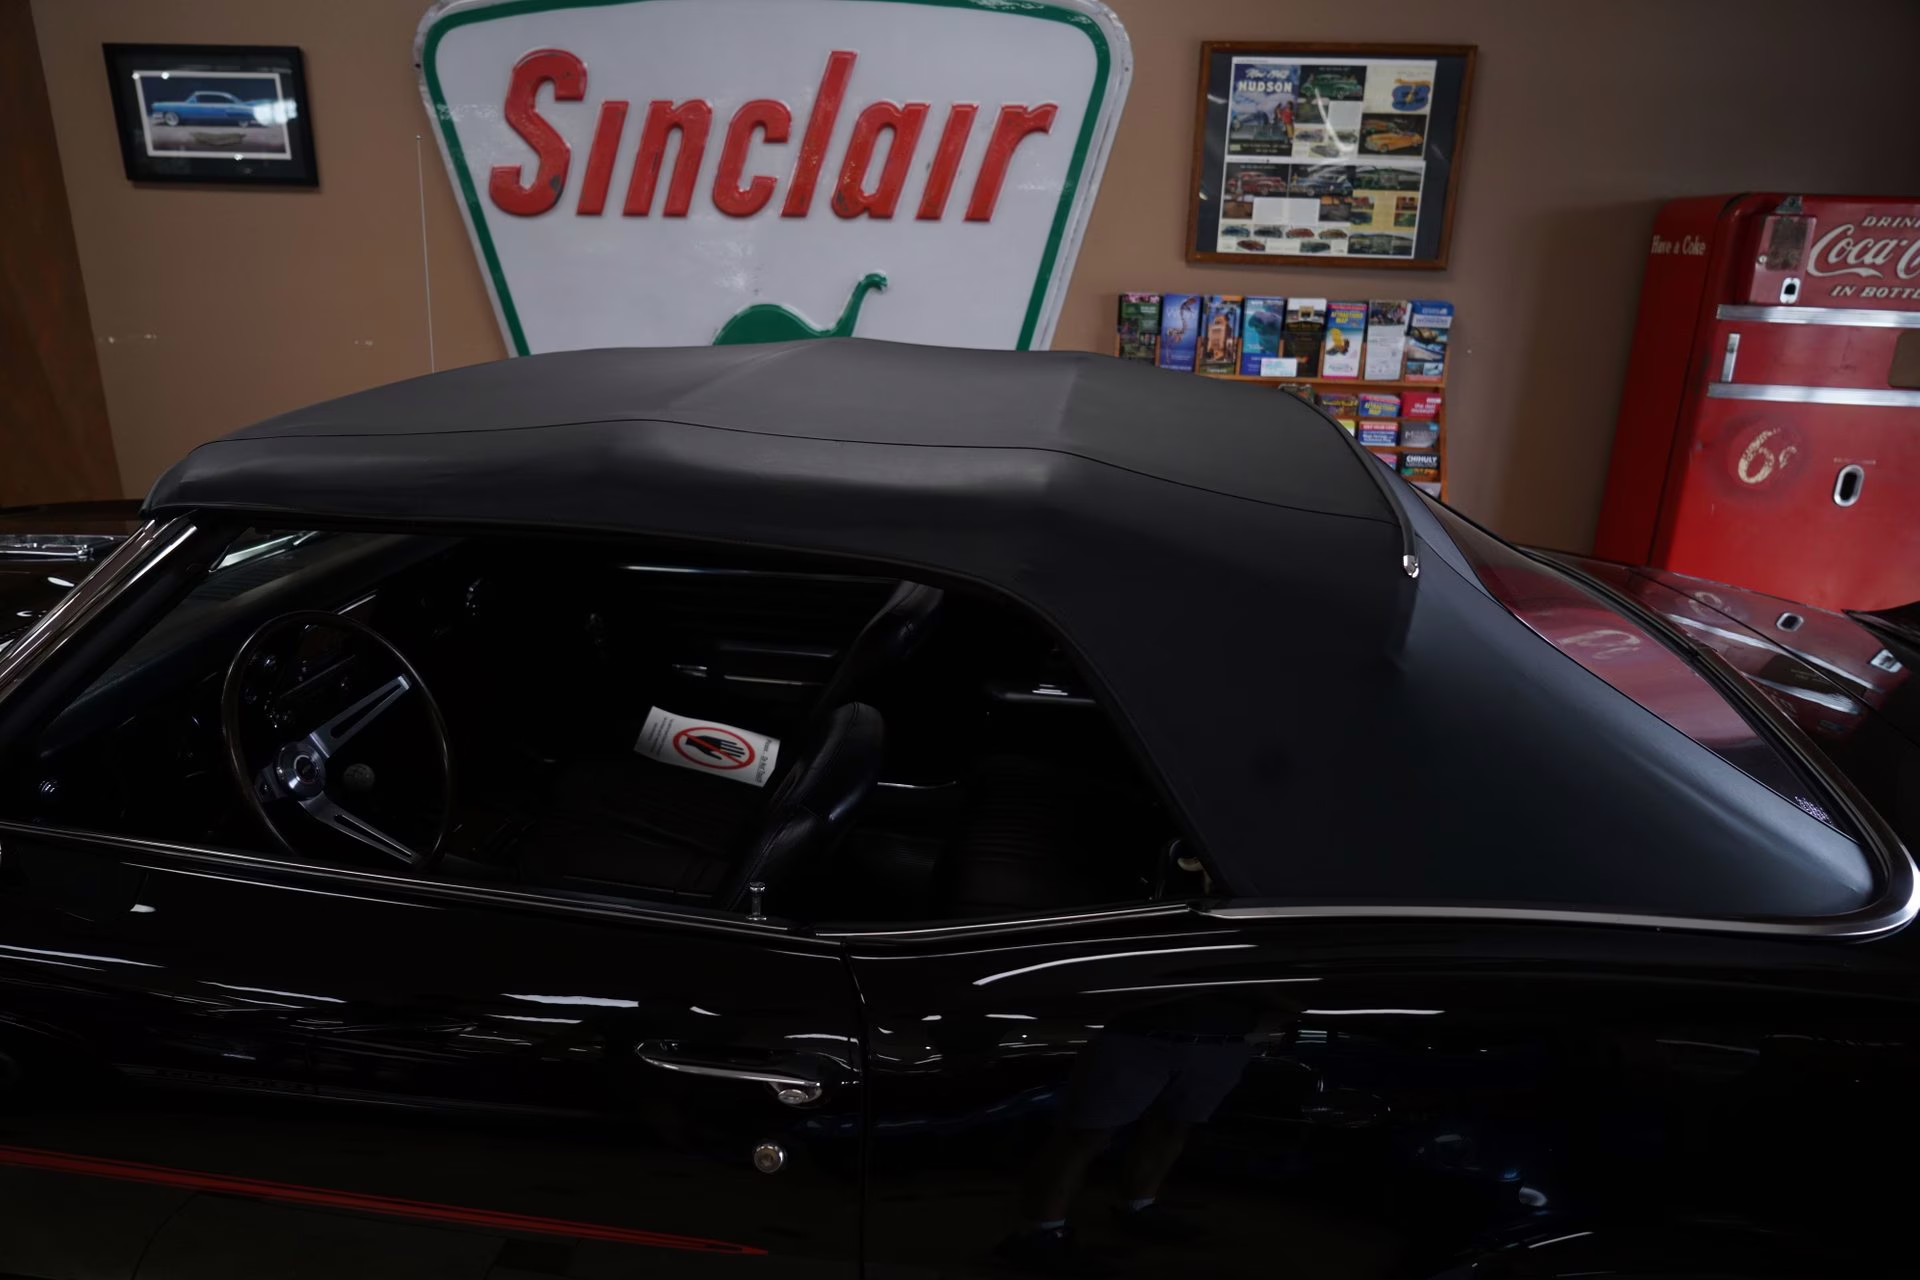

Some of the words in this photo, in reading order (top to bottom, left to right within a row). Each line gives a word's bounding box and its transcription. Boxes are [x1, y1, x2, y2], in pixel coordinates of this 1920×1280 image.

[1238, 80, 1293, 93] HUDSON
[488, 48, 1059, 223] Sinclair
[1682, 234, 1707, 256] Coke
[1830, 285, 1858, 297] IN
[1406, 454, 1438, 464] CHIHULY
